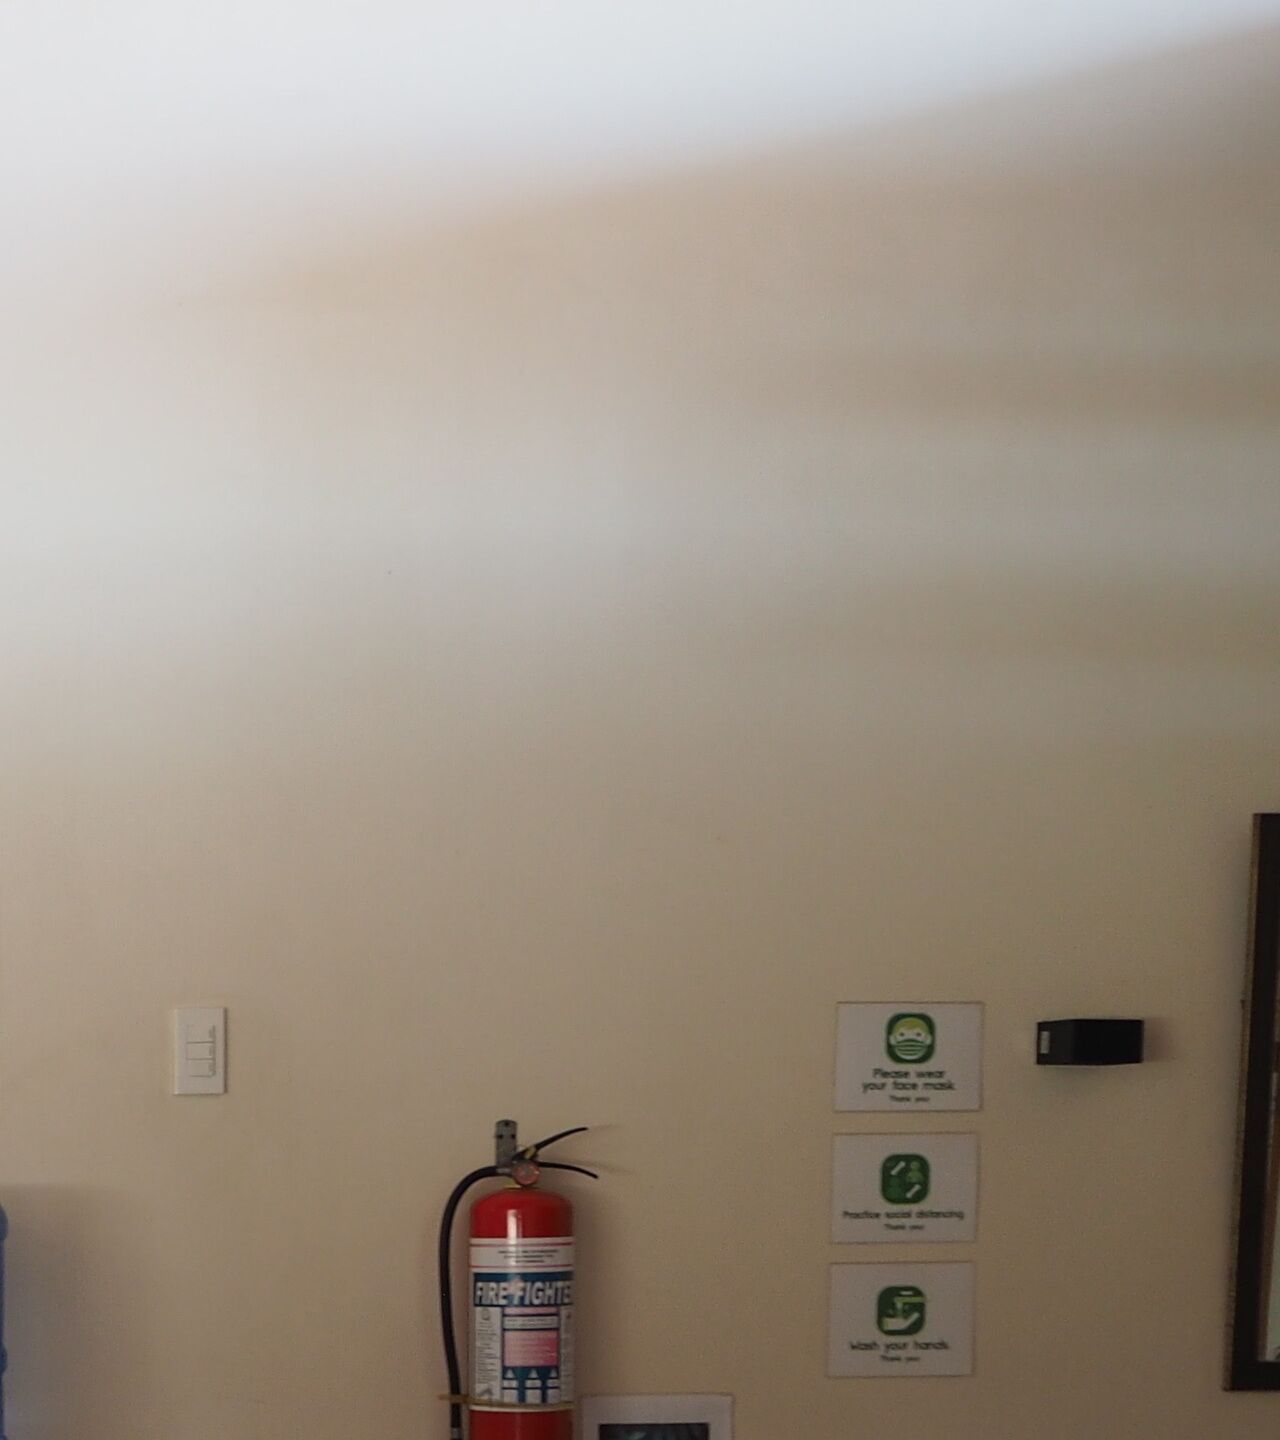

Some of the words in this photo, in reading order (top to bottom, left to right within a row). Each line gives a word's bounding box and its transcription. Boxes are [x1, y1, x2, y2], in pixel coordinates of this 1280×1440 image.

[872, 1068, 910, 1078] Please
[915, 1070, 945, 1078] wear
[862, 1082, 886, 1094] your
[893, 1080, 918, 1090] face
[842, 1210, 881, 1219] Practice
[885, 1210, 911, 1219] social
[915, 1209, 965, 1221] distancing
[475, 1282, 508, 1305] FIRE
[884, 1342, 909, 1353] your
